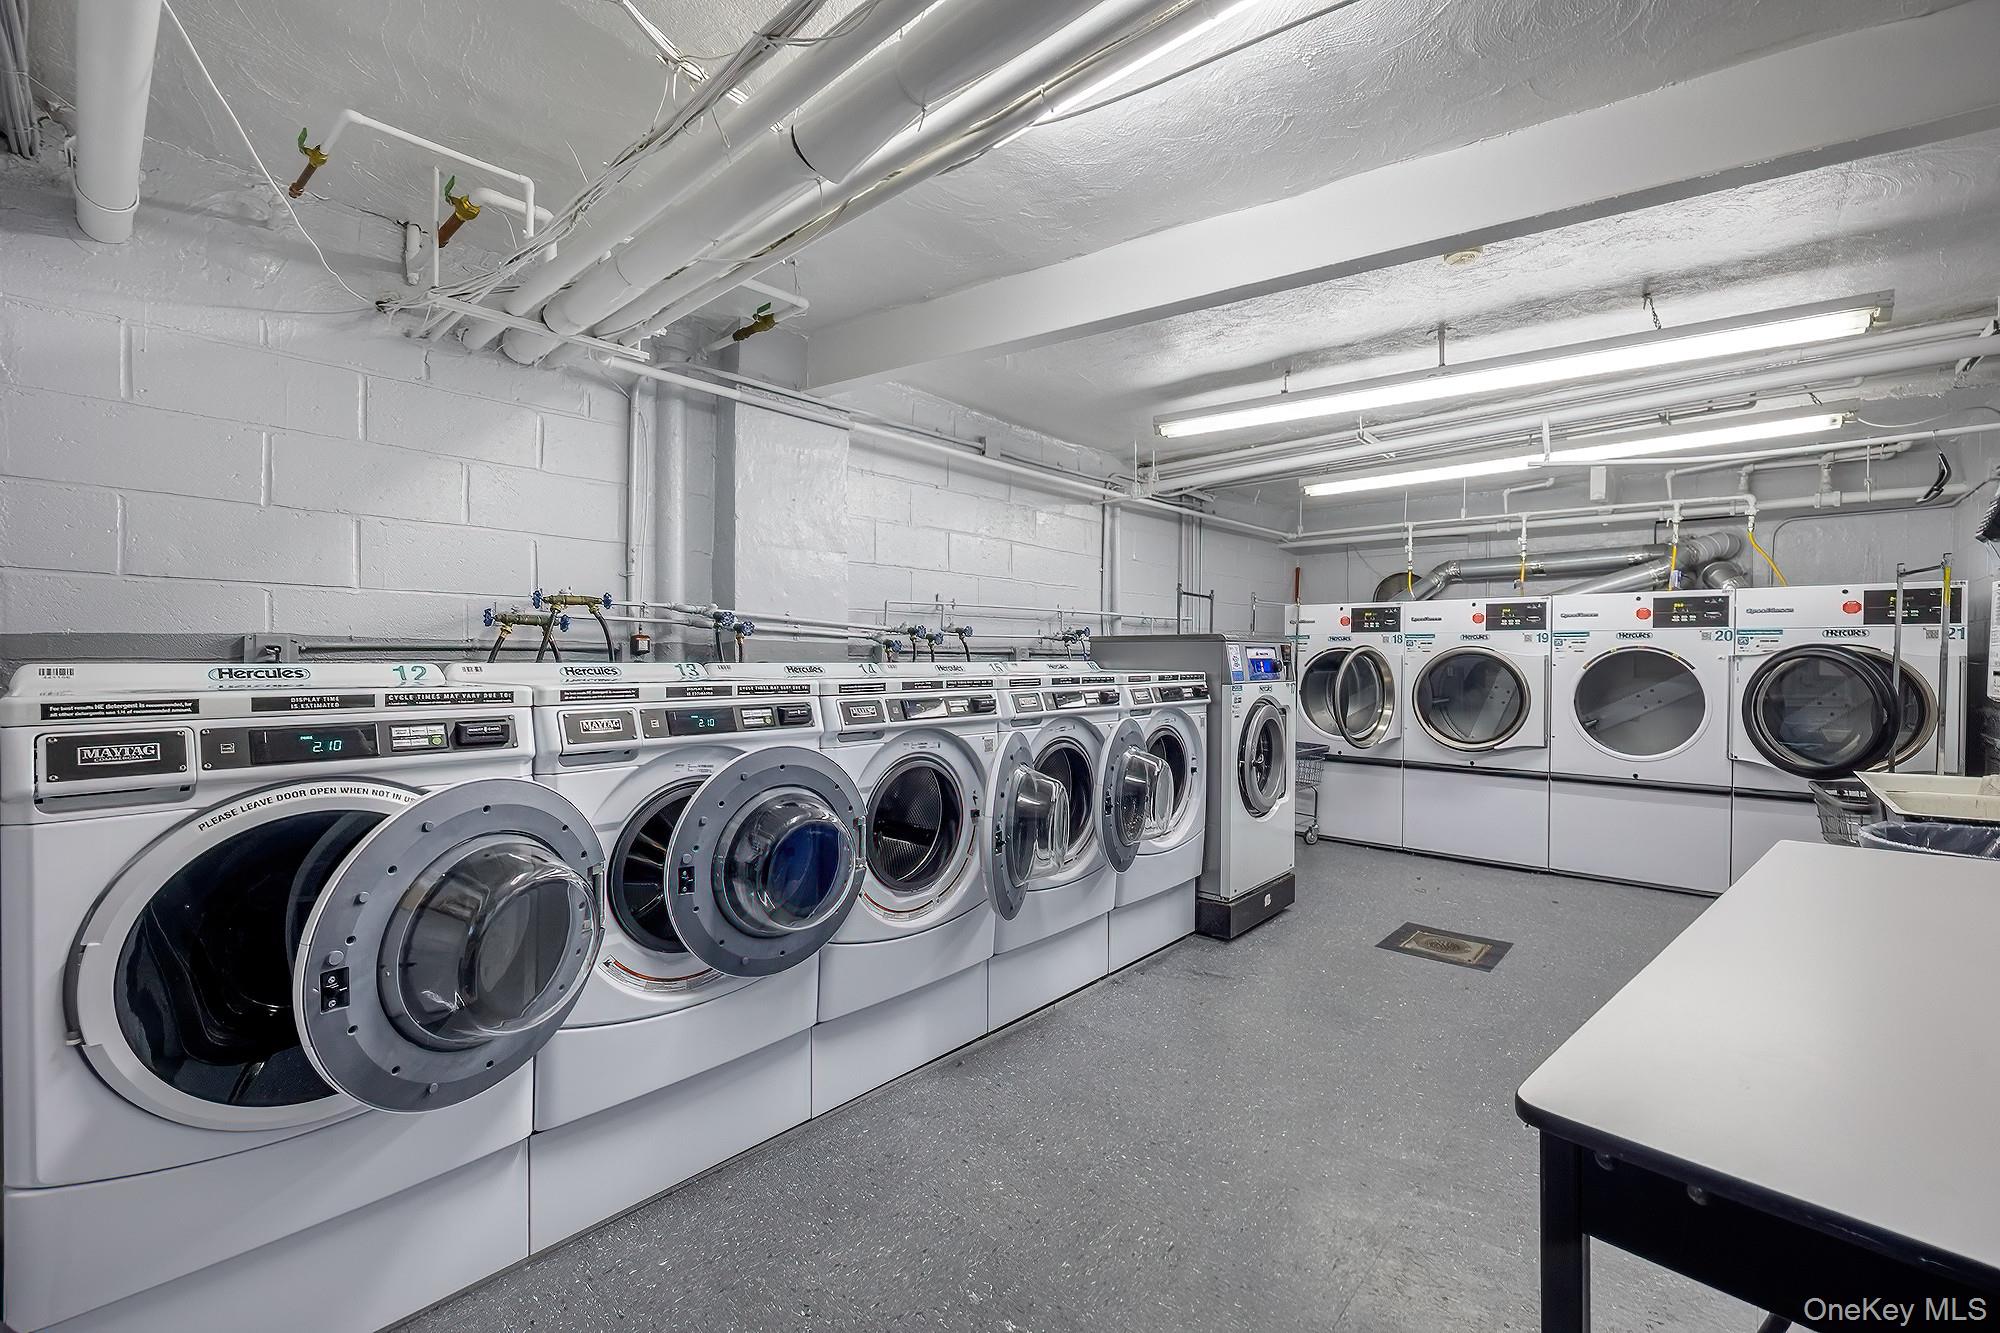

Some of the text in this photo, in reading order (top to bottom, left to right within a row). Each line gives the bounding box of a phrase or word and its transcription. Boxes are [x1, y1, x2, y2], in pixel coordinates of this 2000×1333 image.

[1392, 634, 1403, 644] 18
[1537, 633, 1549, 643] 19
[1715, 630, 1733, 642] 20
[1948, 627, 1965, 640] 21
[216, 667, 305, 679] Hercules
[392, 665, 427, 681] 12
[564, 666, 619, 676] Hercules
[675, 663, 700, 677] 13
[785, 665, 824, 674] Hercules
[105, 702, 138, 710] detergent
[581, 720, 620, 731] MAYTAG
[699, 718, 715, 728] 2.10
[312, 740, 342, 752] 2.10
[82, 745, 156, 760] MAYTAG
[198, 786, 417, 832] PLEASE LEAVE DOOR OPEN WHEN NOT IN US
